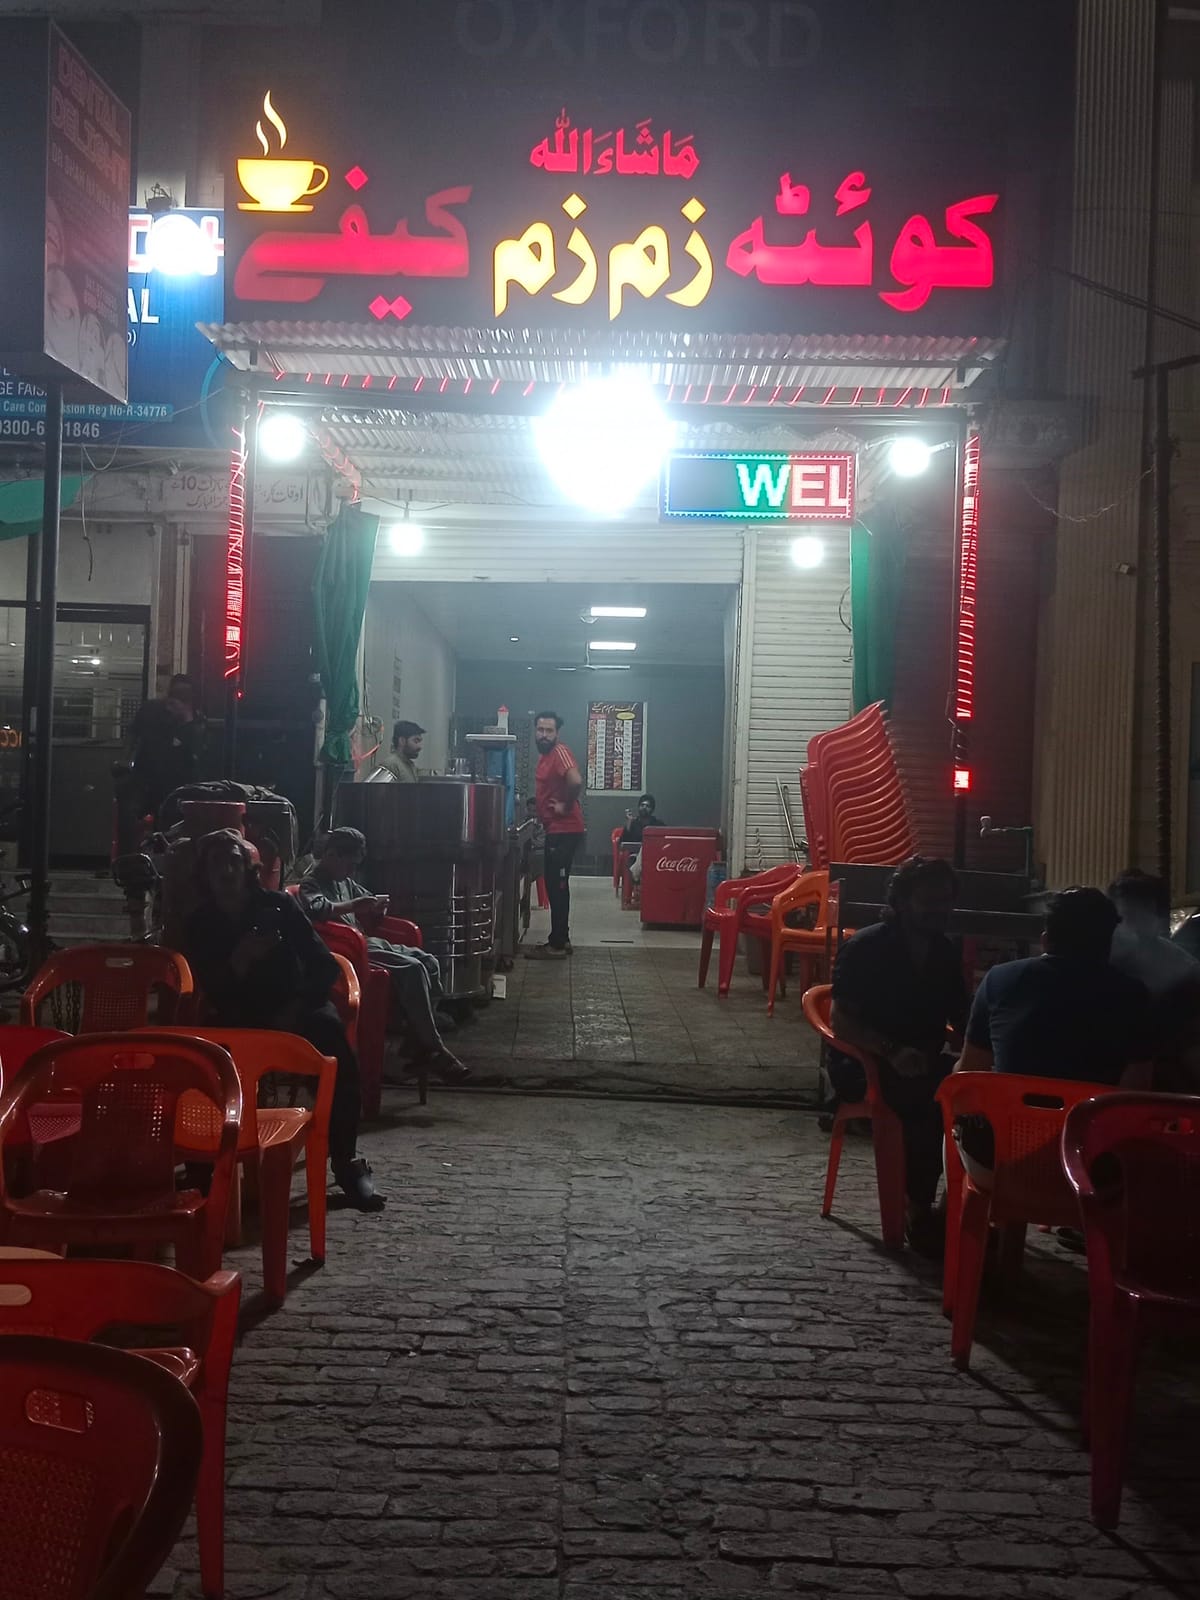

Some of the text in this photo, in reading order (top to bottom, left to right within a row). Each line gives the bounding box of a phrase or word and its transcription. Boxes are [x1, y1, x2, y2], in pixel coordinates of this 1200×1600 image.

[454, 0, 822, 69] OXFORD
[492, 192, 598, 318] زم
[608, 197, 714, 321] زم
[726, 172, 999, 312] کوئٹہ
[736, 463, 849, 507] WEL
